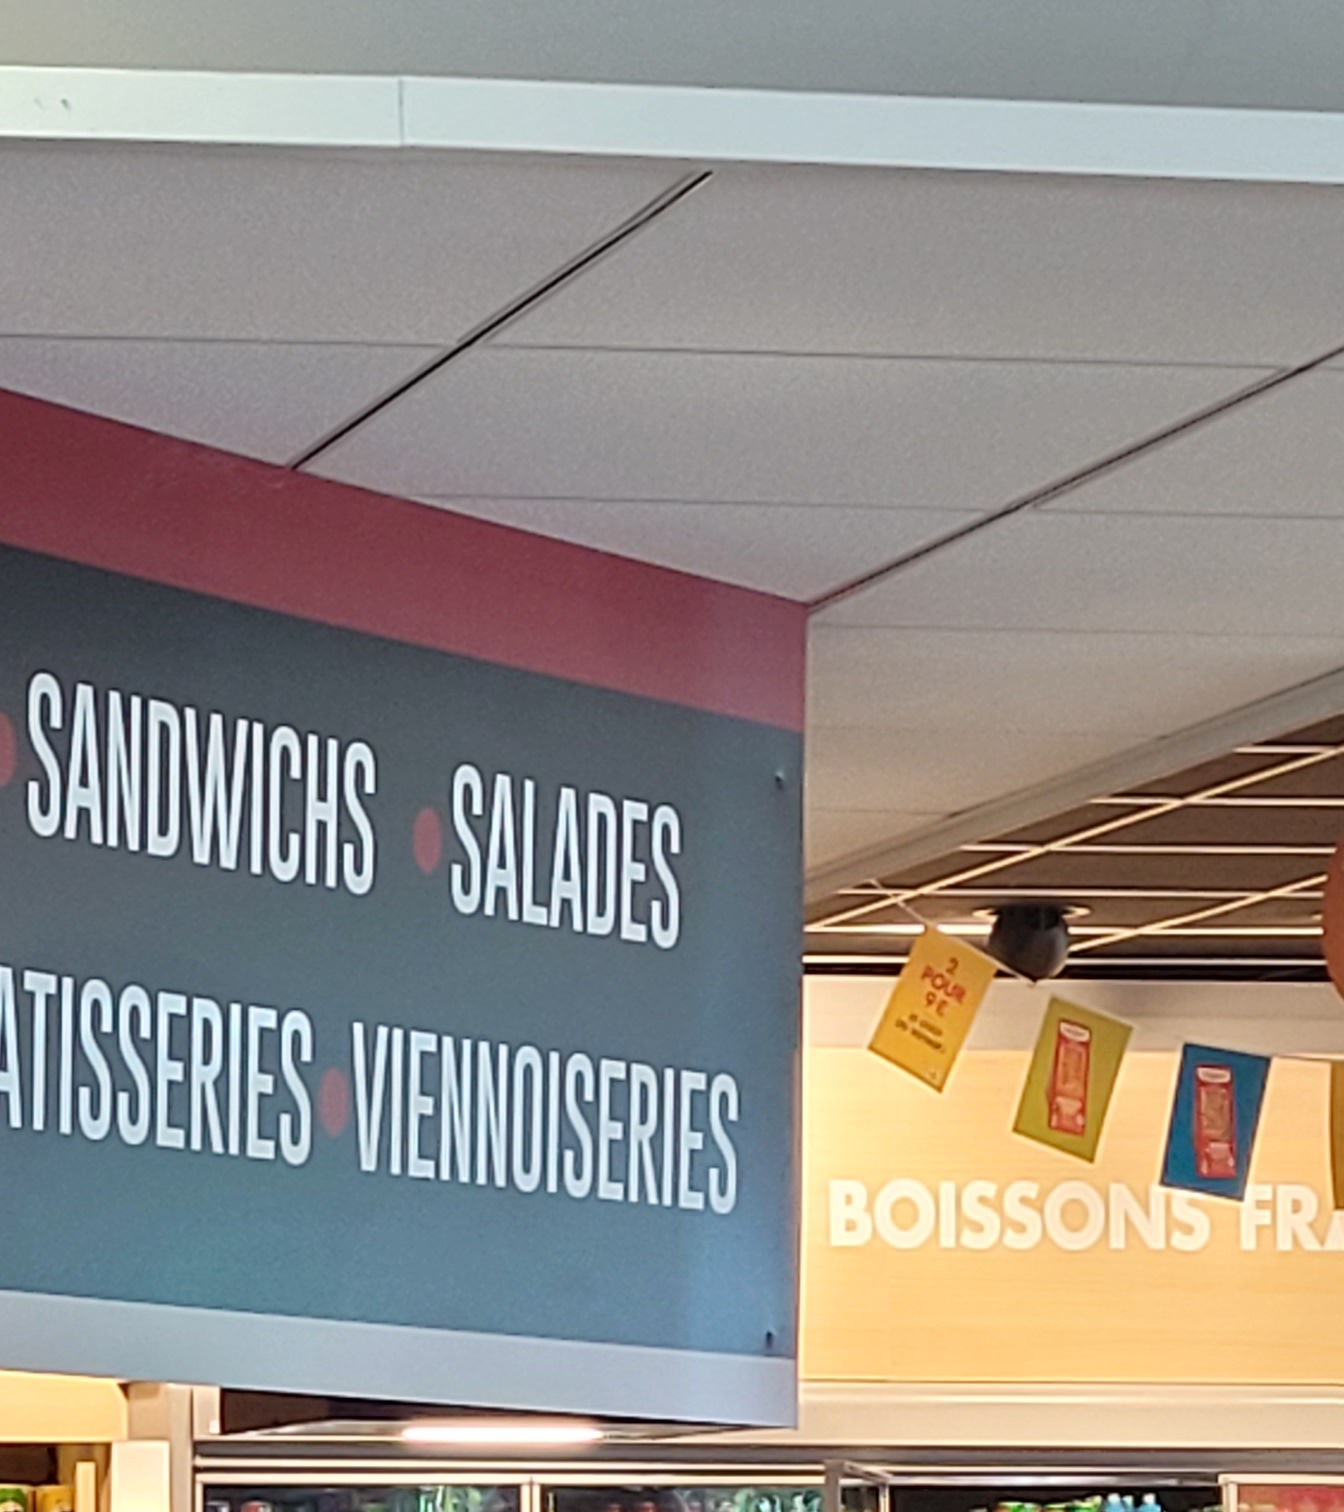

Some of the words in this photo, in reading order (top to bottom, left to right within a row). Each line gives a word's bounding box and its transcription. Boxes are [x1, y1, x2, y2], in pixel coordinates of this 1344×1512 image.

[26, 672, 376, 895] SANDWICHS
[450, 764, 681, 949] SALADES
[352, 1021, 740, 1215] VIENNOISERIES
[828, 1178, 1211, 1252] BOISSONS
